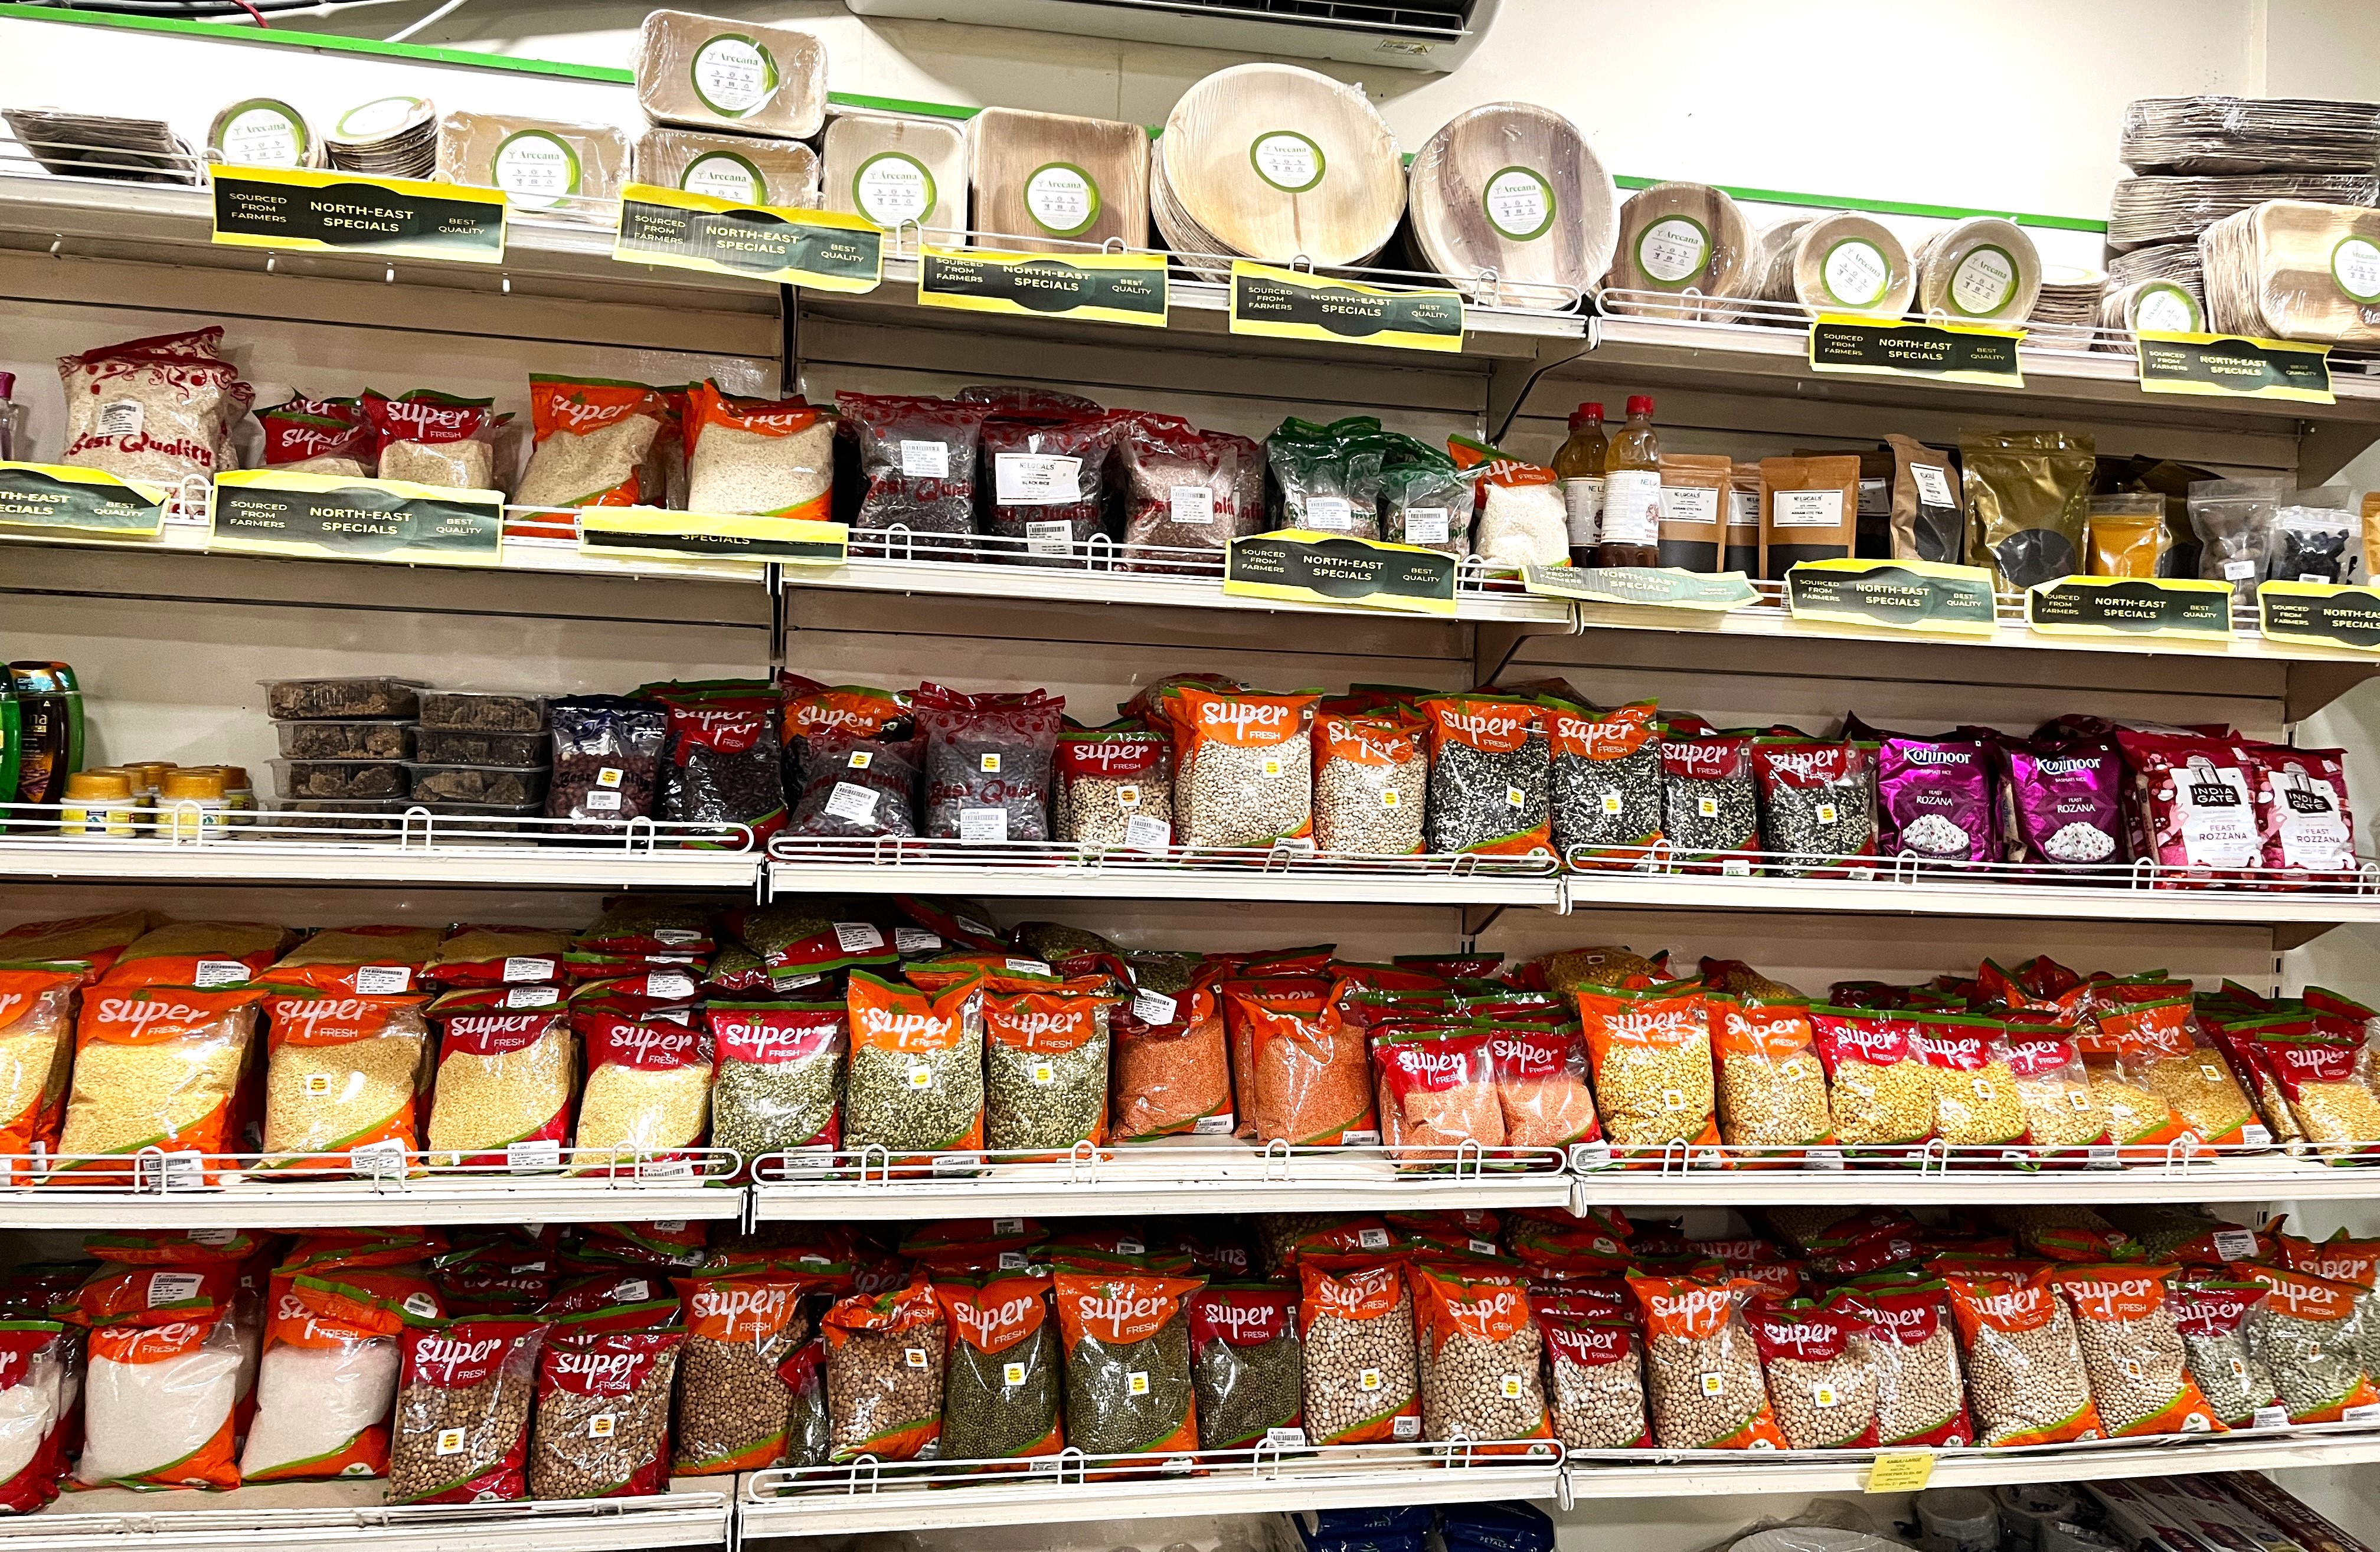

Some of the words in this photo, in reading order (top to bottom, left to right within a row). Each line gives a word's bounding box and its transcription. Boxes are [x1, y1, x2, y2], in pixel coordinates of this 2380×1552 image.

[230, 193, 287, 204] SOURCED
[241, 204, 276, 212] FROM
[310, 201, 414, 220] NORTH-EAST
[231, 212, 286, 223] FARMERS
[635, 215, 686, 227] SOURCED
[323, 218, 399, 233] SPECIALS
[439, 226, 485, 235] QUALITY
[644, 225, 675, 234] FROM
[633, 233, 684, 245] FARMERS
[707, 227, 799, 244] NORTH-EAST
[717, 240, 786, 254] SPECIALS
[831, 244, 855, 253] BEST
[821, 251, 864, 262] QUALITY
[945, 266, 975, 274] FROM
[1003, 266, 1090, 280] NORTH-EAST
[937, 273, 983, 283] FARMERS
[1015, 278, 1079, 292] SPECIALS
[1111, 286, 1152, 294] QUALITY
[1248, 287, 1293, 296] SOURCED
[1310, 294, 1392, 306] NORTH-EAST
[1248, 303, 1293, 312] FARMERS
[1322, 304, 1381, 317] SPECIALS
[1411, 310, 1449, 319] QUALITY
[1823, 333, 1863, 342] SOURCED
[1878, 338, 1952, 351] NORTH-EAST
[1825, 348, 1863, 356] FARMERS
[1888, 351, 1943, 361] SPECIALS
[2149, 350, 2186, 359] SOURCED
[2200, 356, 2267, 368] NORTH-EAST
[2211, 366, 2262, 376] SPECIALS
[387, 401, 469, 438] super
[282, 426, 359, 455] super
[120, 431, 212, 466] Quality
[0, 491, 70, 503] TH-EAST
[0, 504, 53, 515] ECIALS
[230, 500, 287, 510] SOURCED
[94, 509, 145, 517] QUALITY
[241, 510, 275, 519] FROM
[310, 507, 412, 522] NORTH-EAST
[230, 519, 285, 529] FARMERS
[322, 522, 398, 535] SPECIALS
[681, 533, 750, 545] SPECIALS
[1241, 549, 1286, 558] SOURCED
[1303, 555, 1384, 570] NORTH-EAST
[1242, 564, 1284, 573] FARMERS
[1313, 568, 1372, 581] SPECIALS
[1402, 574, 1440, 582] QUALITY
[1799, 579, 1840, 587] SOURCED
[1856, 584, 1929, 596] NORTH-EAST
[1802, 594, 1840, 603] FARMERS
[1865, 596, 1920, 607] SPECIALS
[2095, 598, 2166, 609] NORTH-EAST
[2104, 610, 2156, 620] SPECIALS
[2324, 609, 2380, 618] NORTH-EAS
[1202, 702, 1288, 740] super
[1440, 709, 1516, 745] super
[1250, 731, 1280, 739] FRESH
[1558, 717, 1635, 754] super
[1483, 739, 1511, 748] FRESH
[1074, 744, 1149, 771] super
[1662, 742, 1728, 773] super
[1903, 746, 1971, 766] Kohinoor
[2036, 757, 2101, 775] Kohinoor
[1916, 795, 1953, 806] ROZANA
[2289, 793, 2323, 803] INDIA
[2057, 803, 2095, 813] ROZANA
[2293, 800, 2326, 810] GATE
[98, 999, 210, 1037] super
[277, 998, 377, 1038] super
[320, 1027, 358, 1037] FRESH
[452, 1014, 538, 1049] super
[493, 1038, 525, 1046] FRESH
[610, 1024, 692, 1063] super
[726, 1026, 813, 1057] super
[1040, 1039, 1072, 1047] FRESH
[1320, 1272, 1393, 1312] super
[2065, 1279, 2152, 1314] super
[1362, 1301, 1388, 1310] FRESH
[2118, 1304, 2146, 1312] FRESH
[2303, 1307, 2335, 1315] FRESH
[1078, 1295, 1168, 1337] super
[1446, 1292, 1516, 1333] super
[740, 1322, 771, 1331] FRESH
[953, 1296, 1032, 1347] super
[1206, 1304, 1273, 1338] super
[1126, 1322, 1158, 1335] FRESH
[995, 1328, 1026, 1345] FRESH
[1552, 1328, 1617, 1359] super
[416, 1338, 502, 1381] super
[457, 1368, 486, 1379] FRESH
